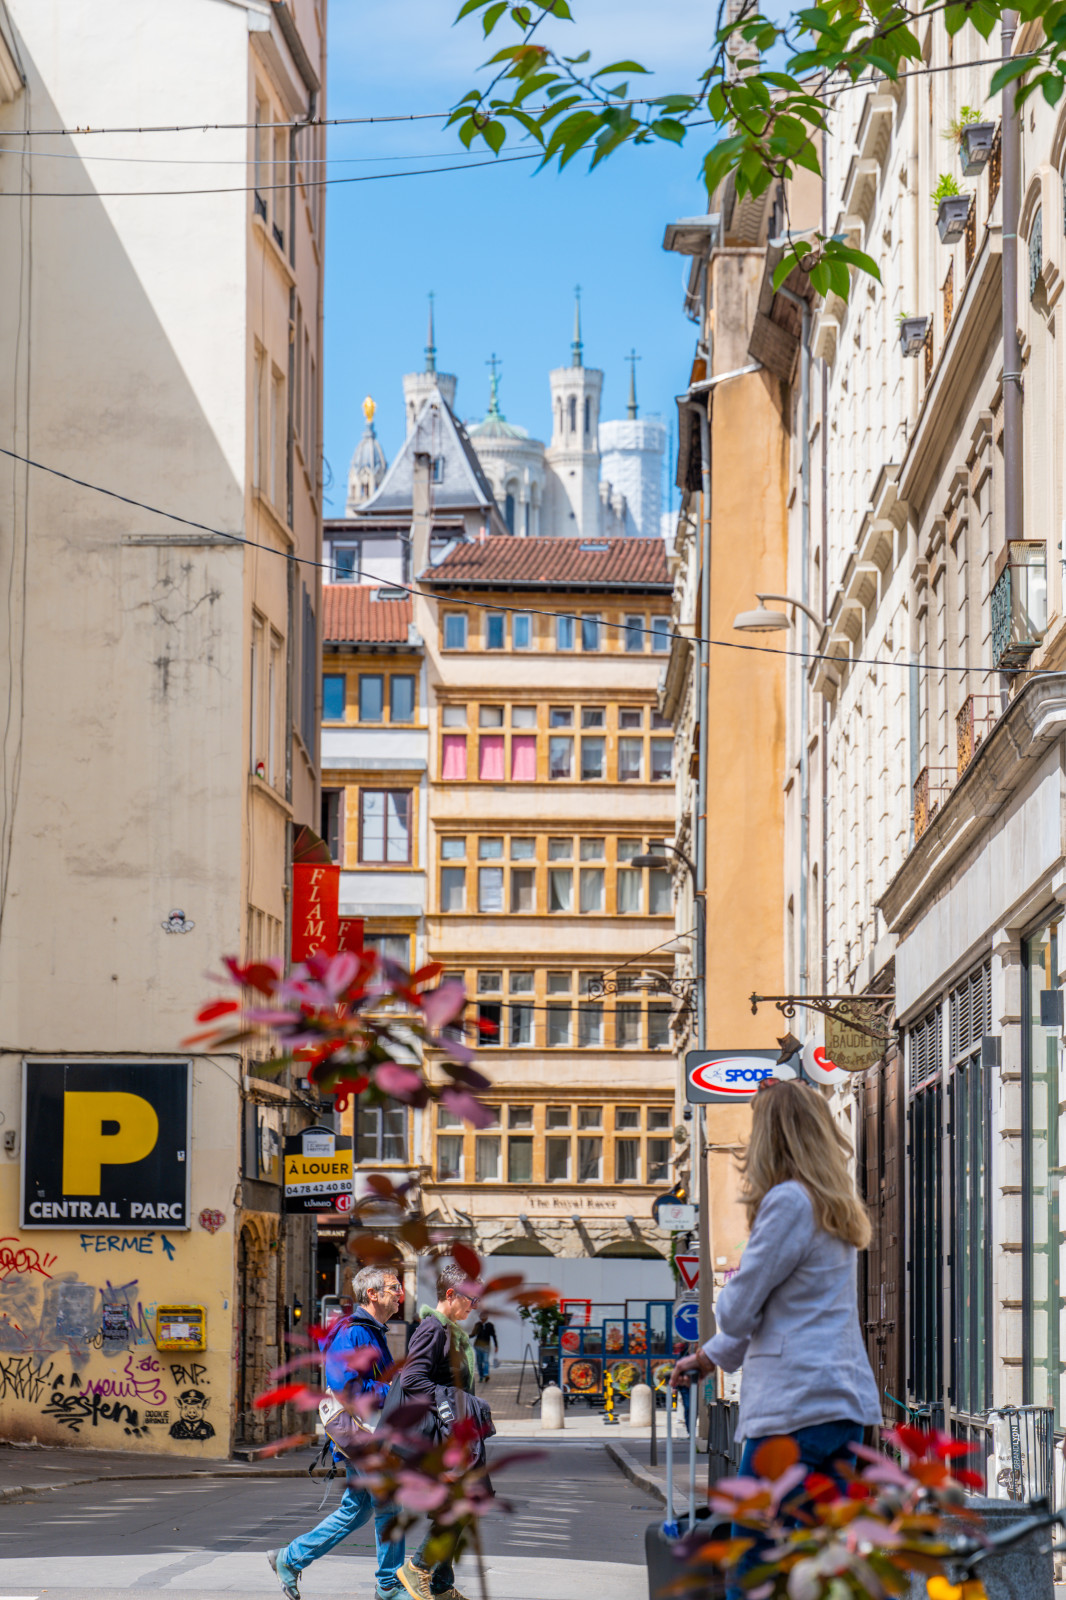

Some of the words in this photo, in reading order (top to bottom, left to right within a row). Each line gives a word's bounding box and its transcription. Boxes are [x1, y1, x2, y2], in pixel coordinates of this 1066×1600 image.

[62, 1091, 159, 1196] P
[289, 1160, 298, 1175] À
[303, 1163, 349, 1175] LOUER
[286, 1187, 298, 1195] 04
[326, 1183, 338, 1191] 40
[340, 1182, 352, 1190] 80
[29, 1202, 121, 1219] CENTRAL
[130, 1202, 182, 1219] PARC
[526, 1197, 549, 1208] The
[80, 1232, 155, 1254] FERMÉ
